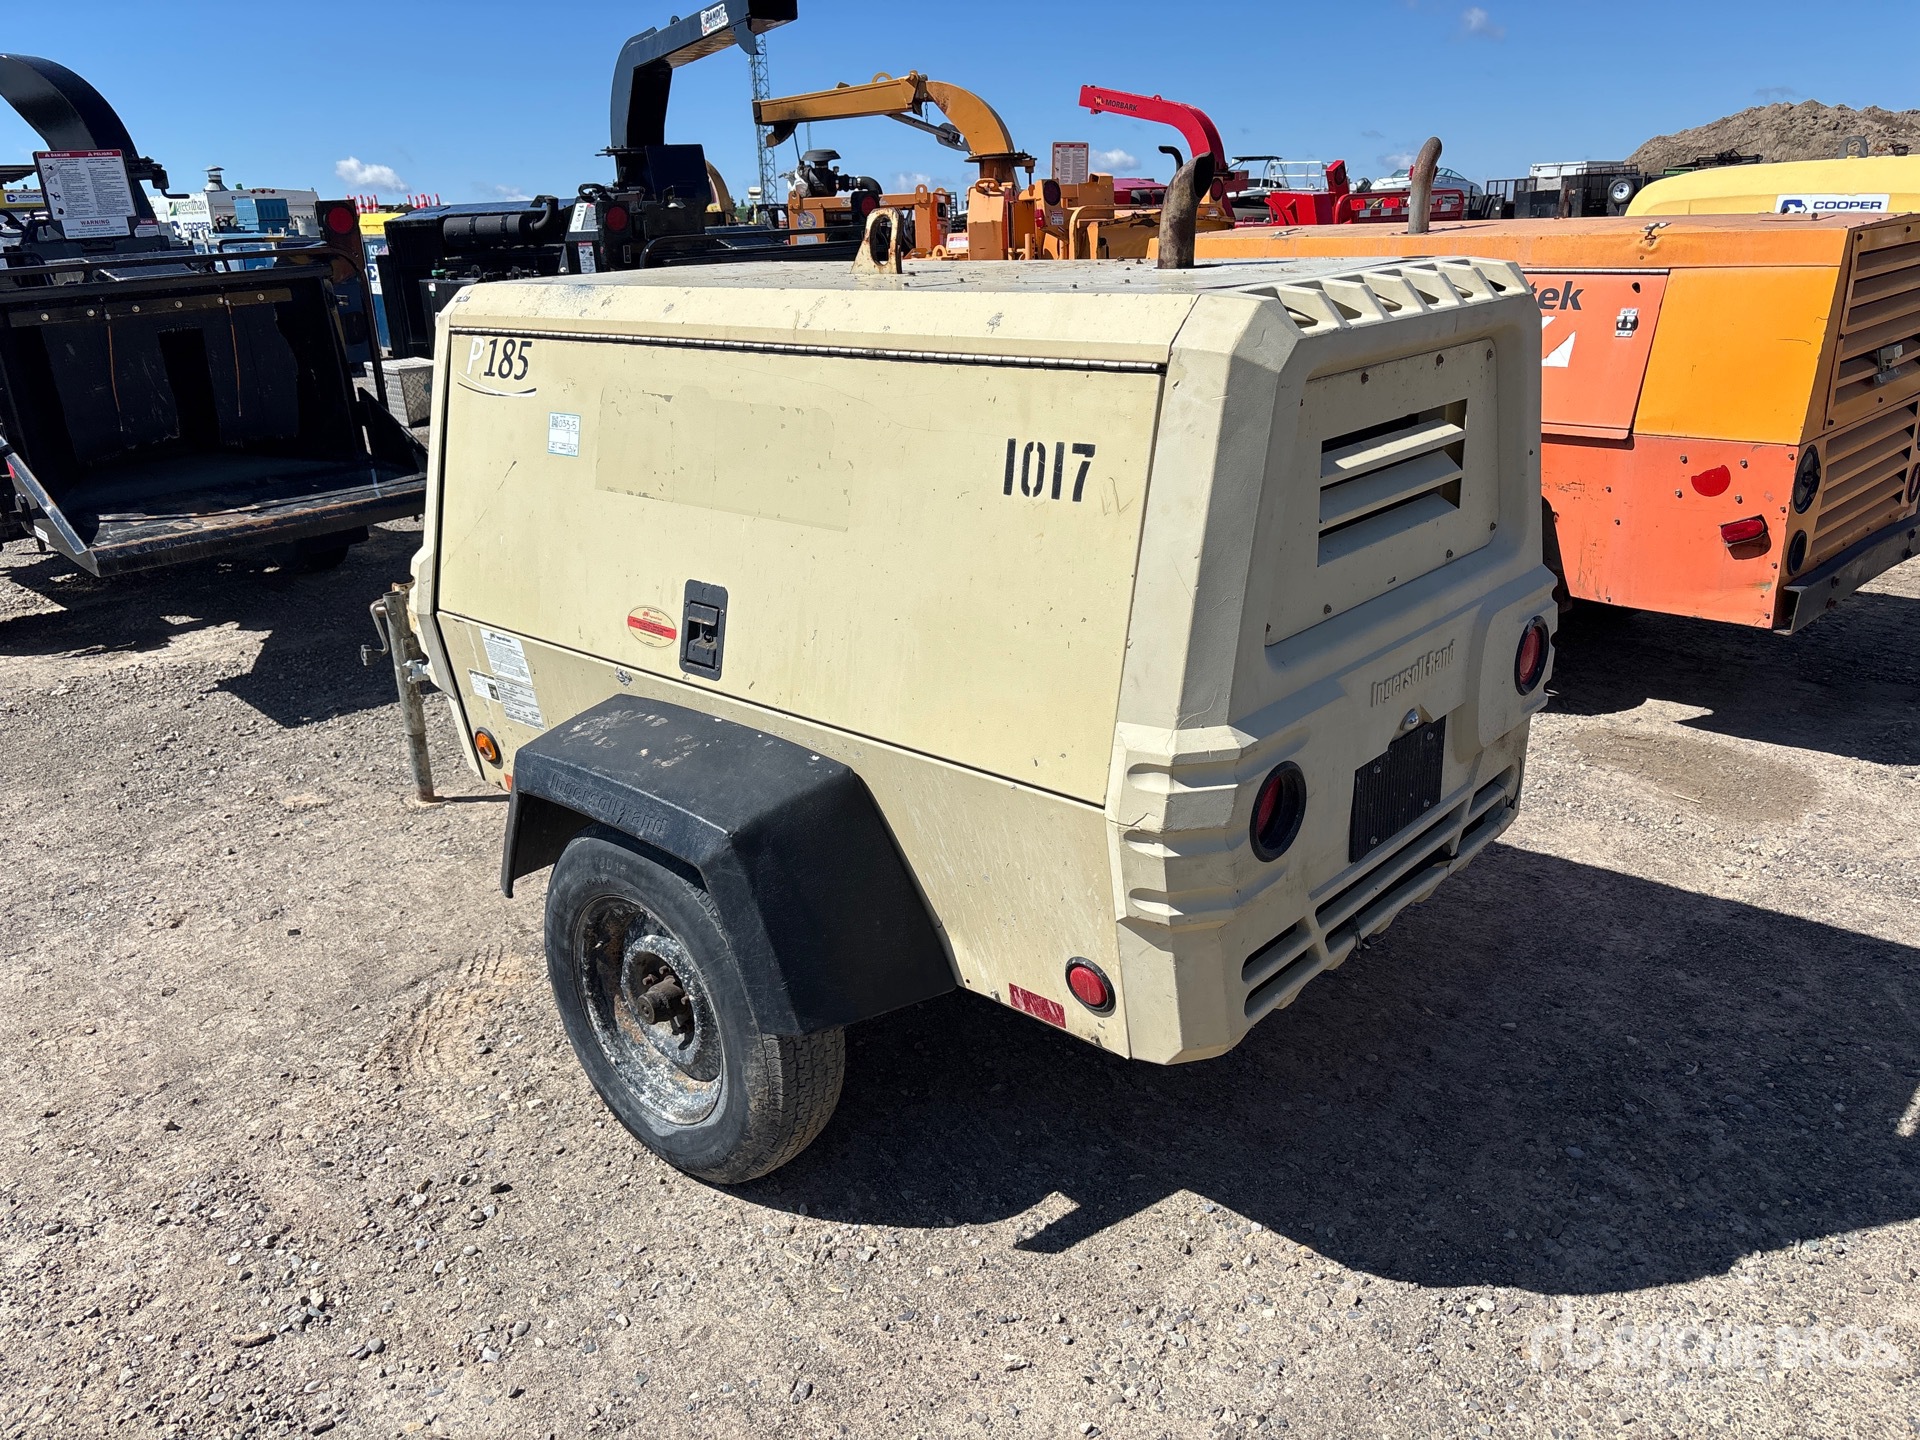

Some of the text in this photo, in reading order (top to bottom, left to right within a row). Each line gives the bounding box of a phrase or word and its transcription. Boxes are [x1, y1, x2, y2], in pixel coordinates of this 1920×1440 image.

[1105, 99, 1138, 111] MORBARK
[1813, 201, 1882, 210] COOPER
[183, 221, 210, 231] COOPER
[467, 336, 533, 380] P185
[1003, 438, 1096, 502] 1017
